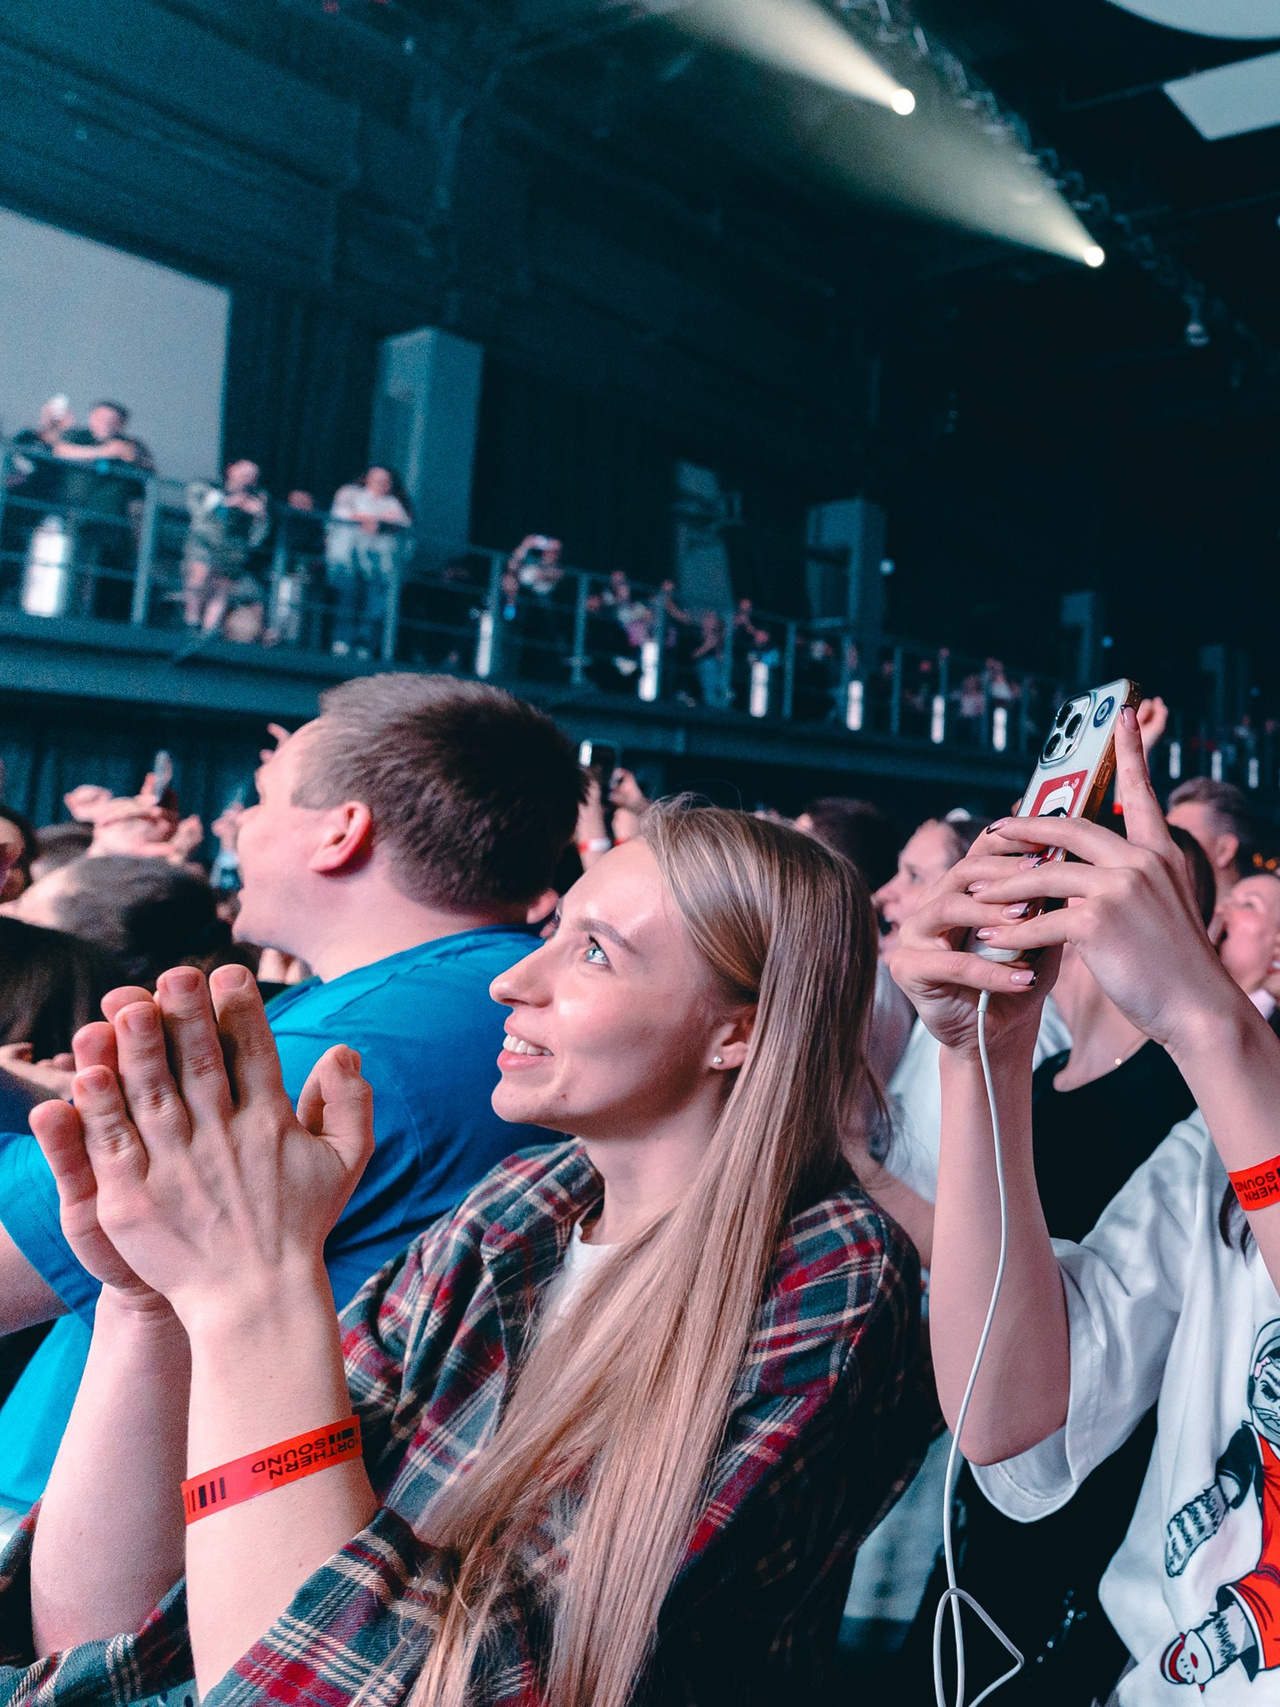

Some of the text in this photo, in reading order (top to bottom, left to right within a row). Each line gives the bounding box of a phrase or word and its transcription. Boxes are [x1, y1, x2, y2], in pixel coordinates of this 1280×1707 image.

[1234, 1171, 1276, 1193] SOUND
[251, 1437, 326, 1474] SOUND
[269, 1438, 358, 1480] ORTHERN
